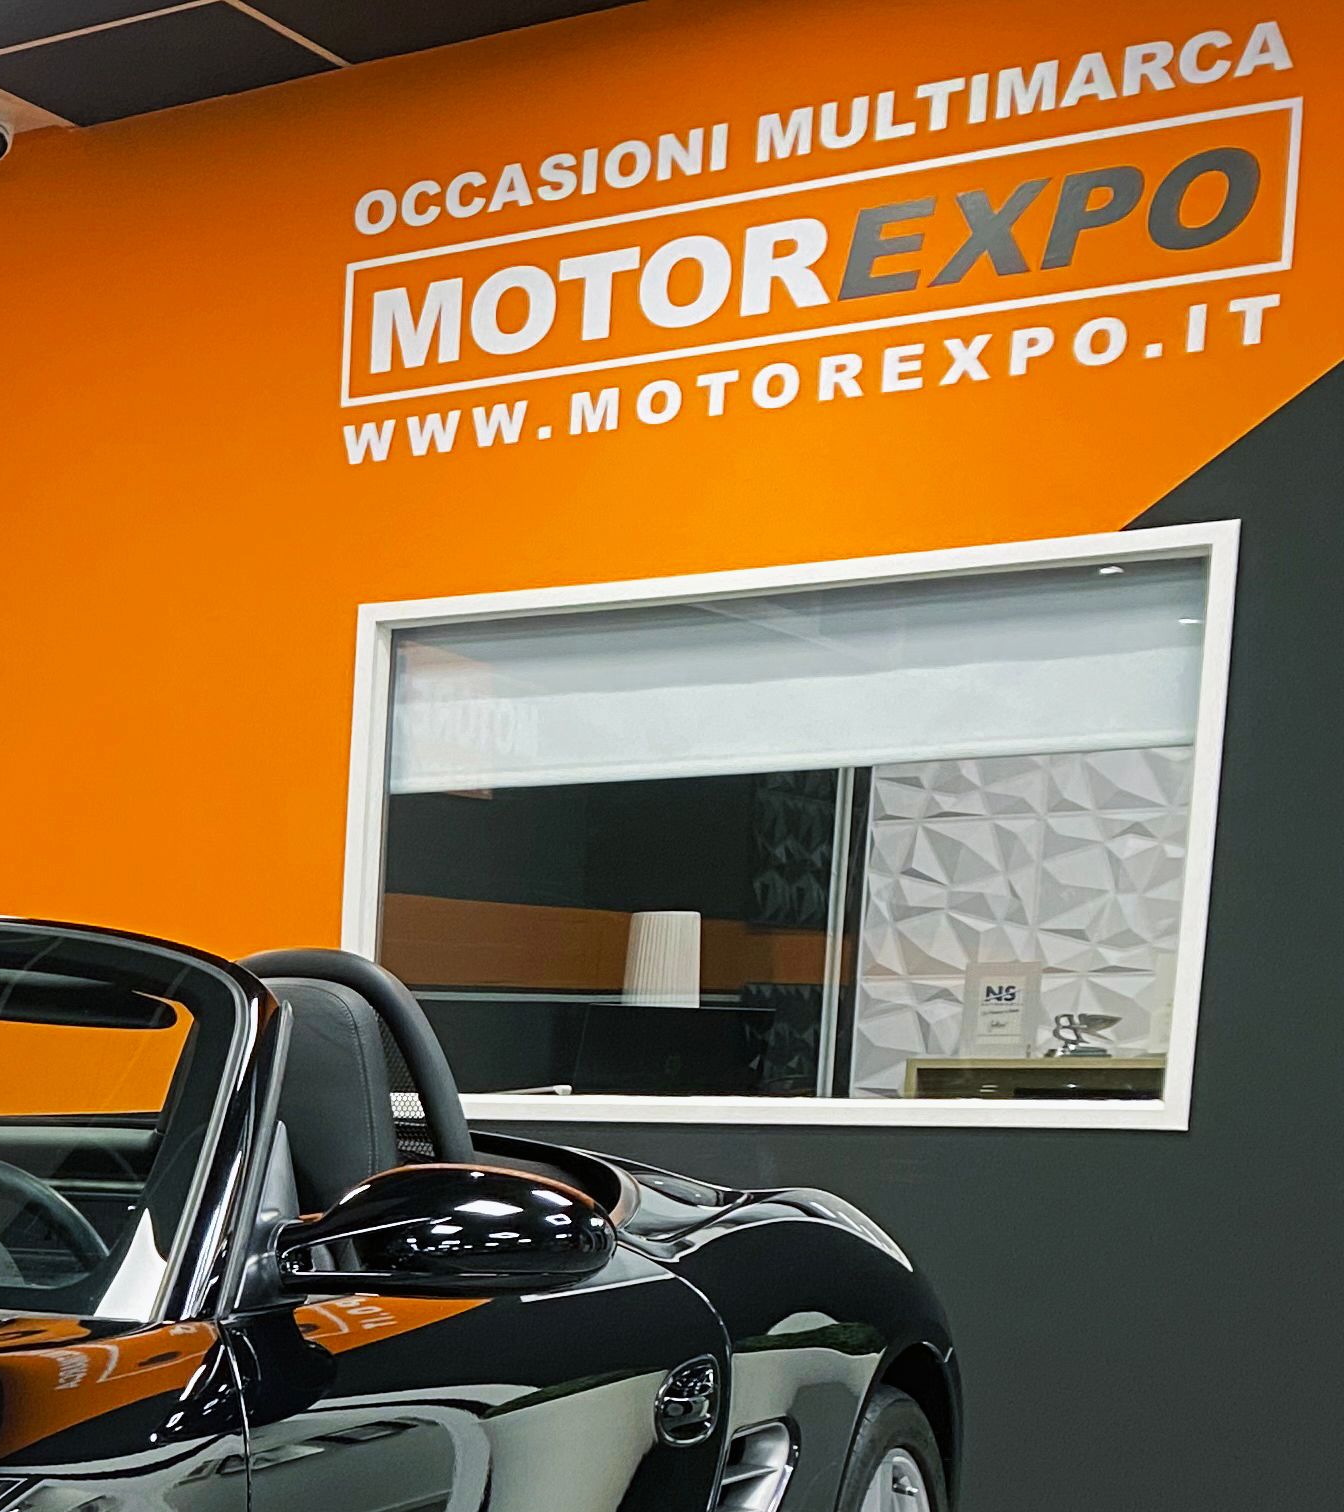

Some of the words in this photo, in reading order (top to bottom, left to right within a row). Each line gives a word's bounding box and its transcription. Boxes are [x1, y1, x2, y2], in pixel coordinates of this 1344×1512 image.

[354, 124, 728, 237] OCCASIONI
[755, 20, 1294, 161] MULTIMARCA
[368, 146, 1260, 374] MOTOREXPO
[343, 294, 1280, 465] WWW.MOTOREXPO.IT
